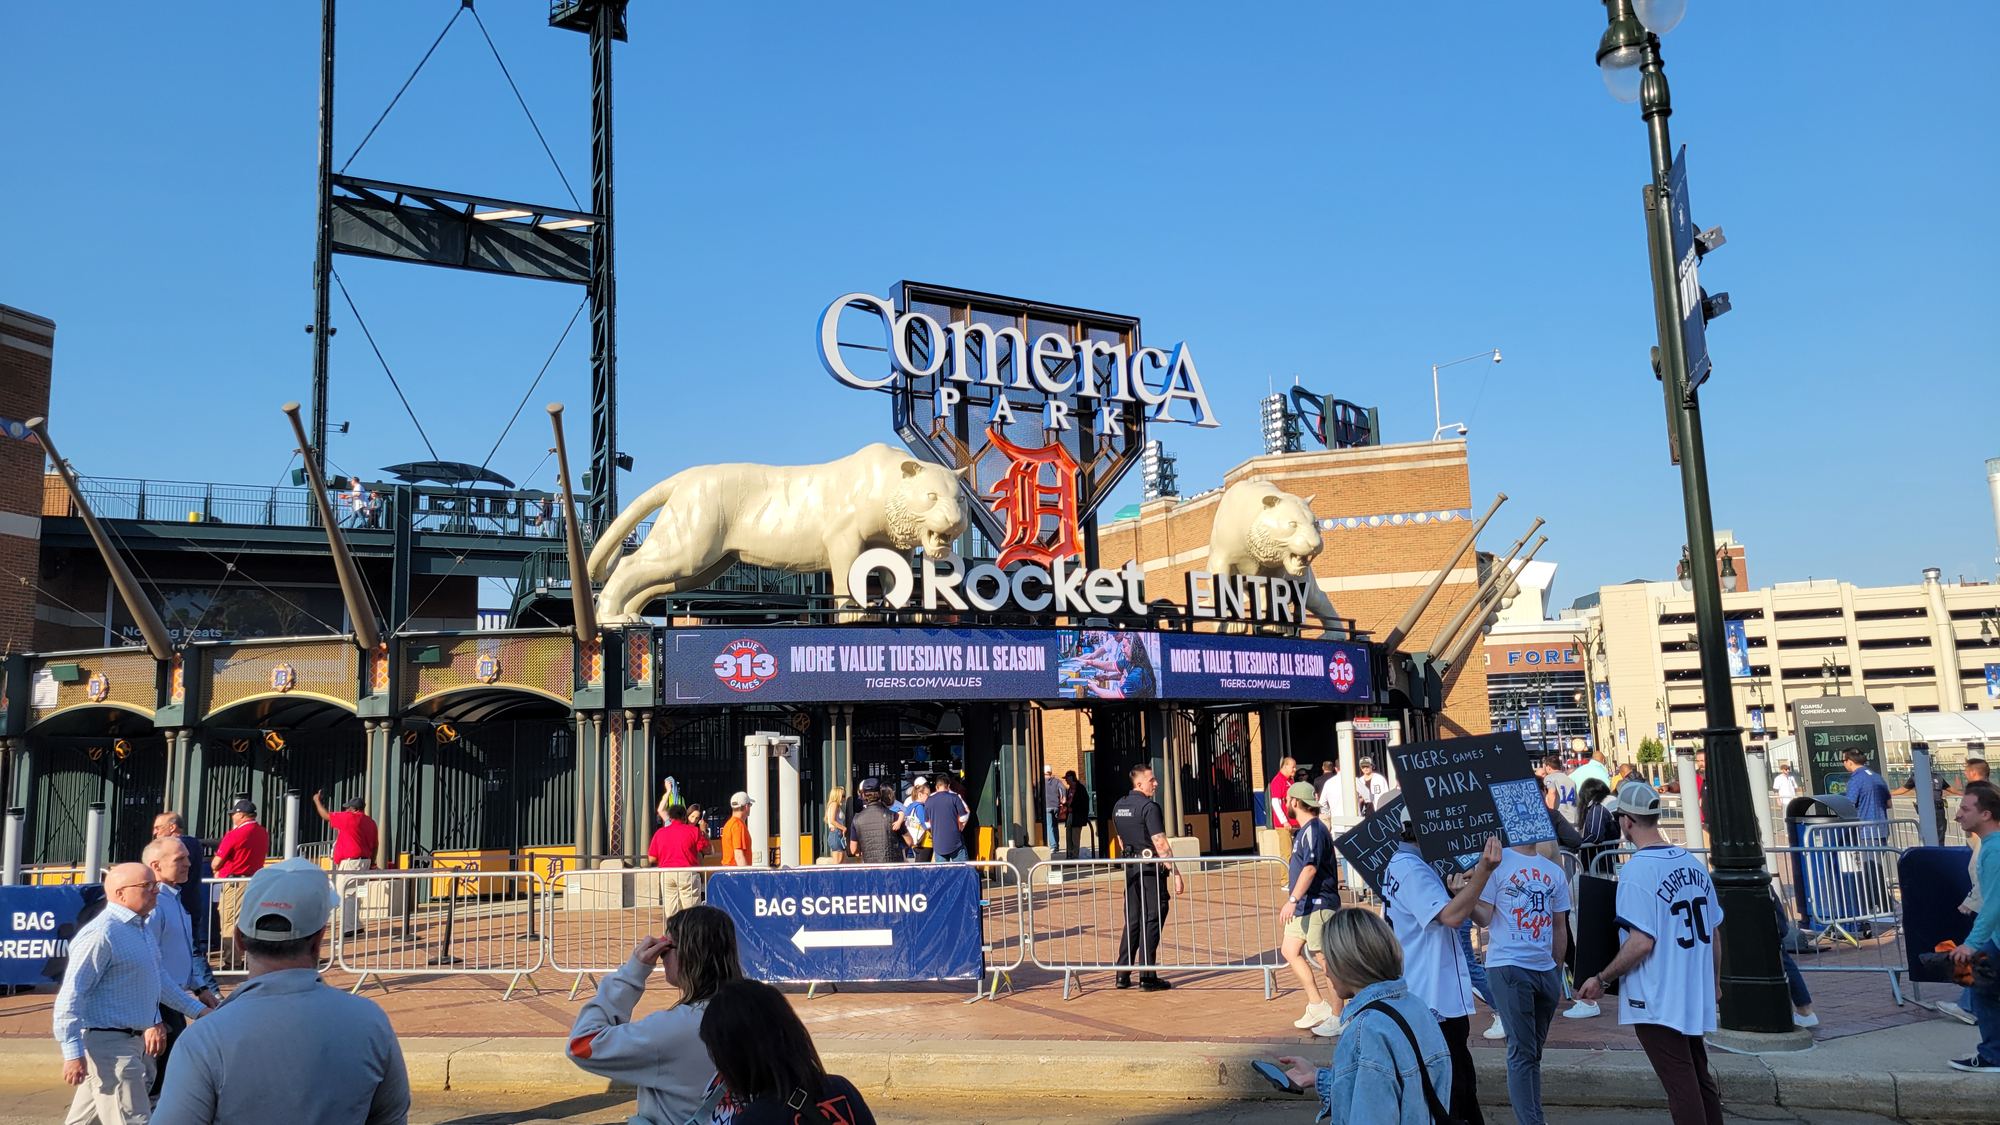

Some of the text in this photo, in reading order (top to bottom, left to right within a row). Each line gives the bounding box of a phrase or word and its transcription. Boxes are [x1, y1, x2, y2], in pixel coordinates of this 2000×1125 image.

[935, 386, 1123, 437] PARK
[922, 553, 1311, 624] Rocket ENTRY
[183, 627, 222, 639] beats
[730, 640, 759, 651] VALUE
[714, 653, 775, 678] 313
[791, 645, 1045, 672] MORE VALUE TUESDAYS ALL SEASON
[1170, 649, 1324, 677] MORE VALUE TUESDAYS ALL SEASON
[865, 677, 982, 688] TIGERS.COM/VALUES
[1328, 662, 1354, 681] 313
[729, 678, 760, 690] GAMES
[1220, 678, 1291, 689] TIGERS.COM/VALUES
[1830, 734, 1868, 743] BETMGM
[1398, 750, 1449, 772] TIGERS
[1452, 749, 1484, 764] GAMES
[1424, 770, 1483, 799] PAIRA
[1420, 812, 1494, 835] DOUBLE DATE
[1424, 804, 1468, 820] THE BEST
[1447, 840, 1460, 852] IN
[1656, 867, 1711, 904] CARPENTER
[755, 893, 928, 917] BAG SCREENING
[13, 911, 55, 931] BAG
[1670, 896, 1711, 950] 30
